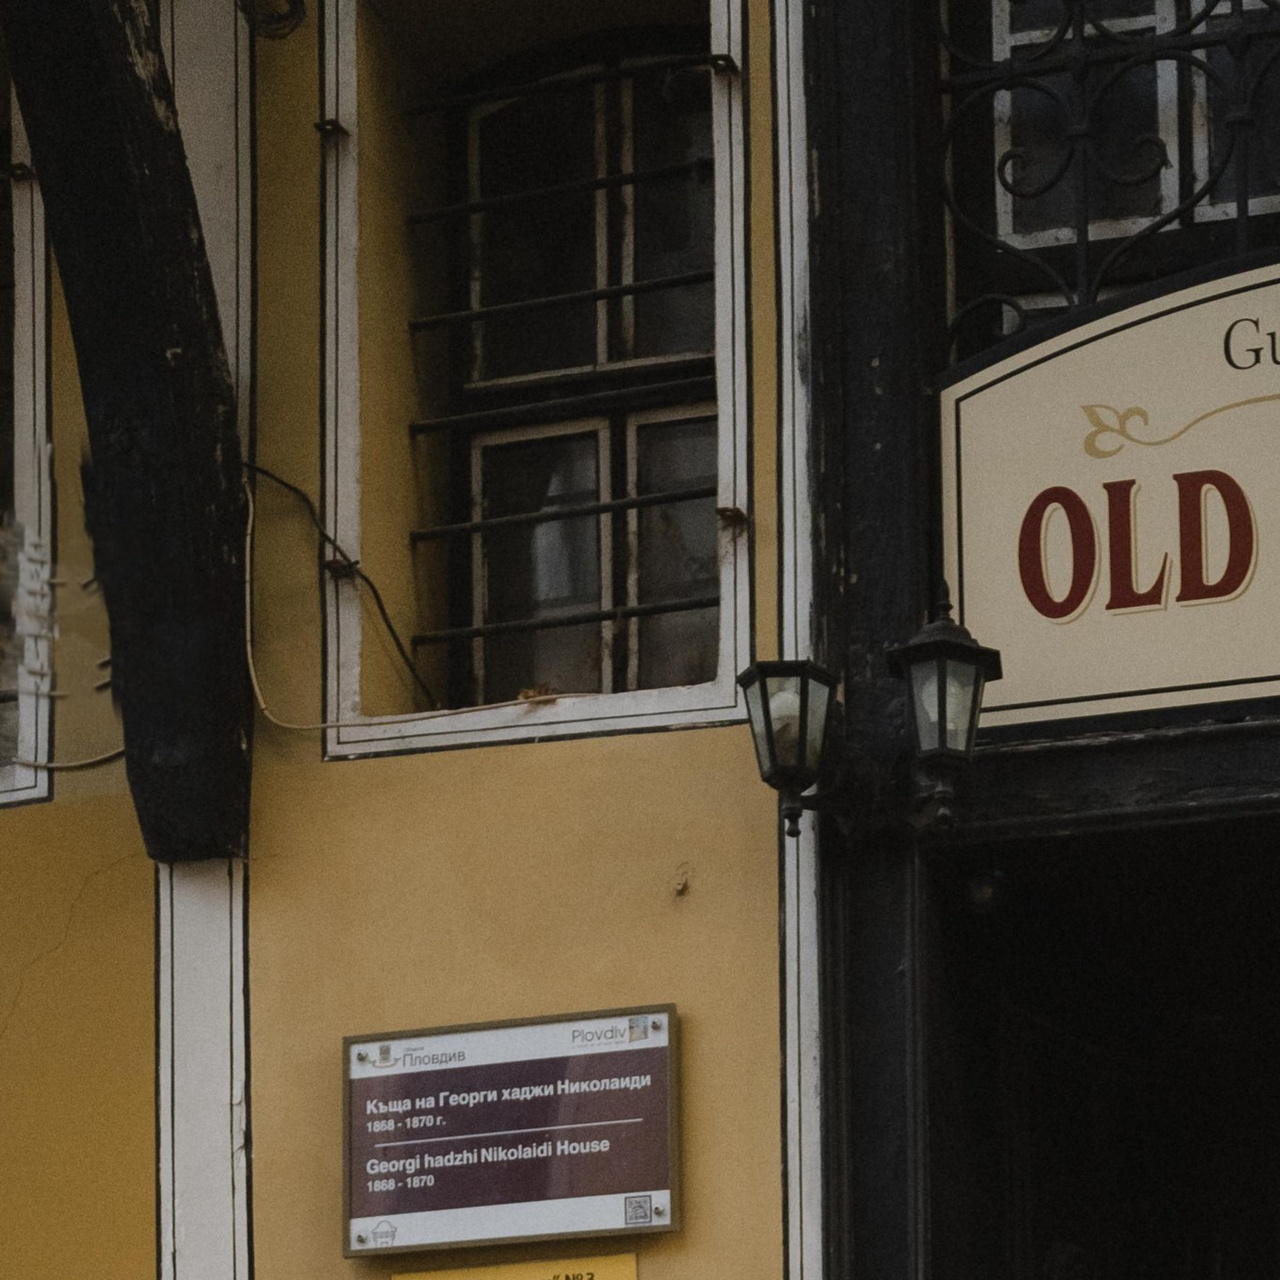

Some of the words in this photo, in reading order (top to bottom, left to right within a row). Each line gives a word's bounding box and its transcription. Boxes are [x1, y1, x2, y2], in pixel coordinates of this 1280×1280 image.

[1017, 468, 1258, 624] OLD
[572, 1025, 627, 1042] Plovdiv
[402, 1051, 466, 1068] Пловдив
[366, 1099, 412, 1115] Къща
[415, 1097, 435, 1109] на
[439, 1090, 498, 1109] Георги
[501, 1083, 553, 1101] хаджи
[557, 1075, 651, 1095] Николаиди
[366, 1119, 395, 1133] 1868
[405, 1115, 434, 1128] 1870
[435, 1116, 447, 1126] г.
[366, 1155, 420, 1176] Georgi
[424, 1147, 478, 1168] hadzhi
[480, 1141, 552, 1163] Nikolaidi
[556, 1138, 610, 1155] House
[367, 1179, 395, 1193] 1868
[406, 1174, 434, 1188] 1870
